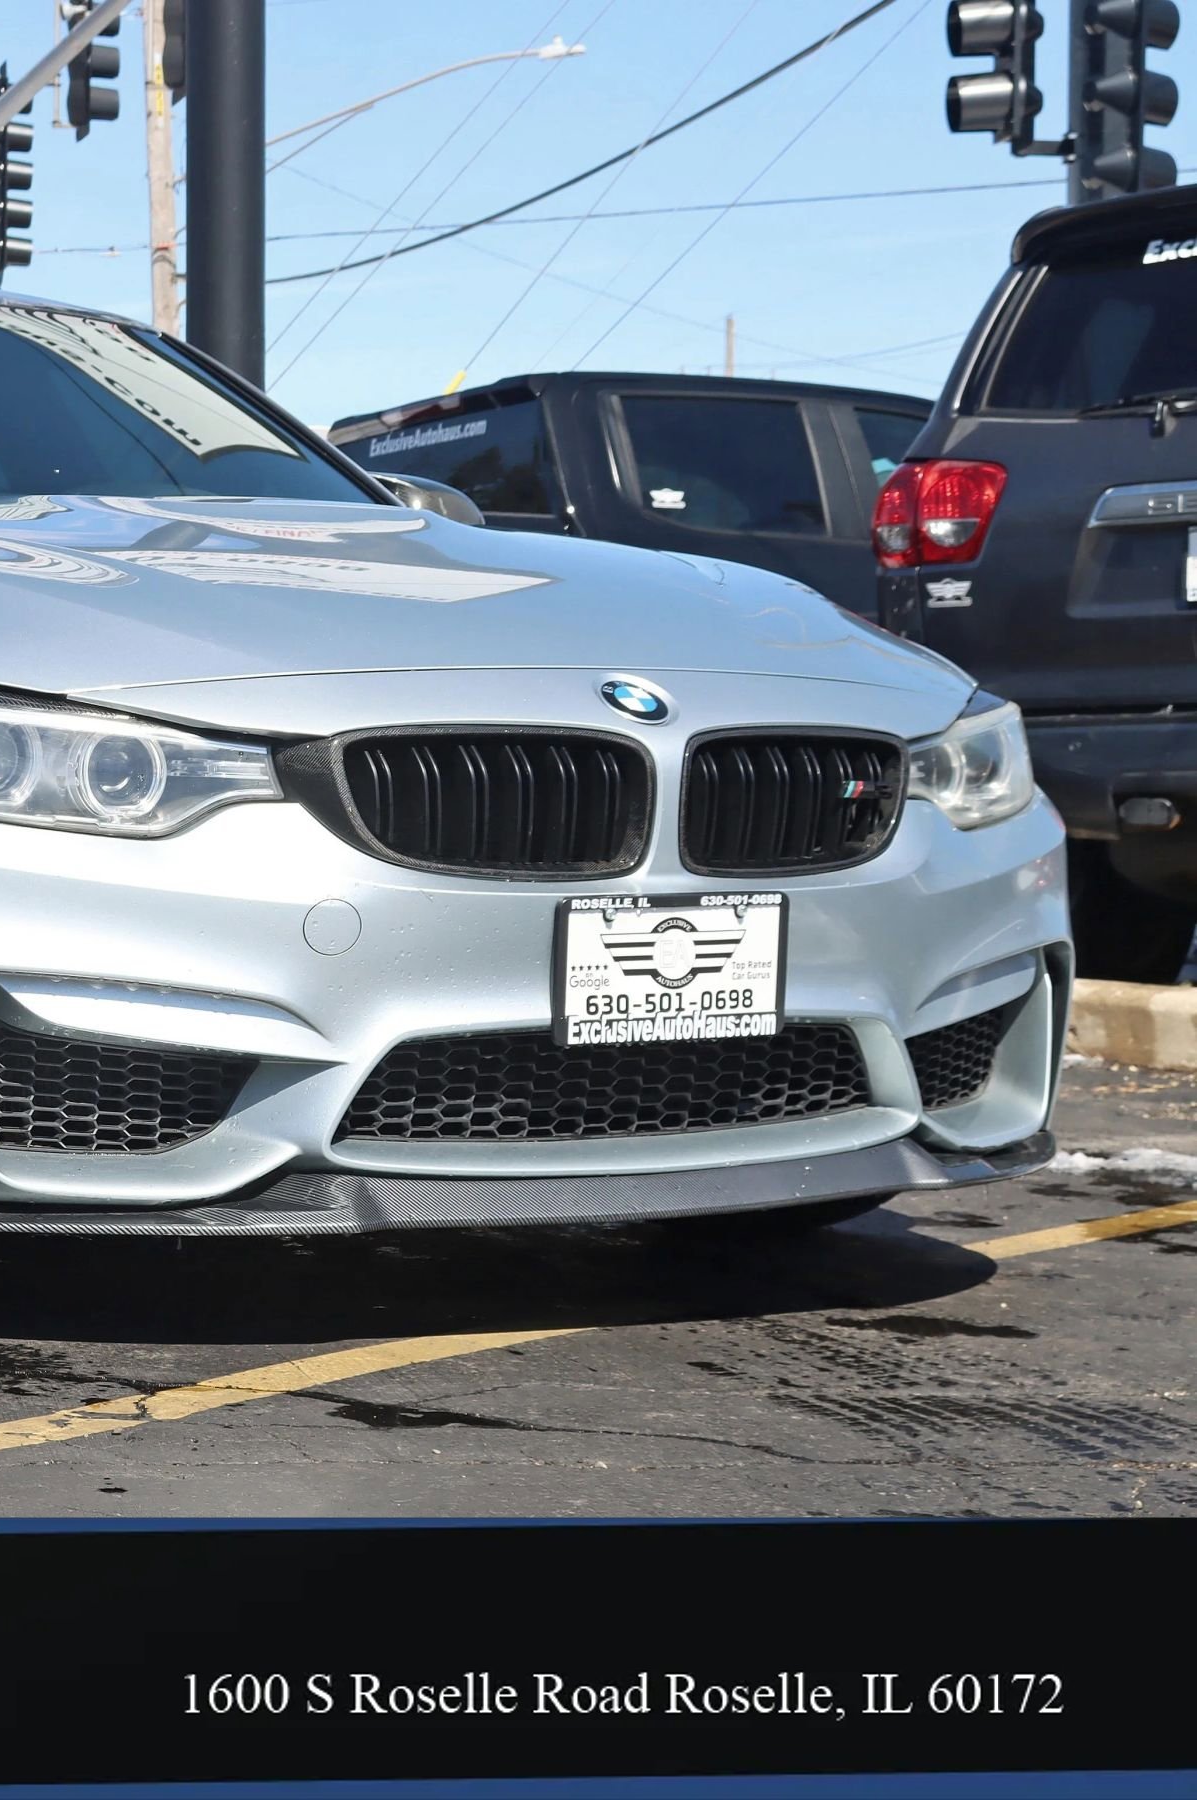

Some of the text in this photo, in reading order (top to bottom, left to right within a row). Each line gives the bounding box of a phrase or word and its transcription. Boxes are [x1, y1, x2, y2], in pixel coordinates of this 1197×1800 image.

[571, 897, 651, 910] ROSELLE, IL
[700, 893, 782, 906] 630-501-0698
[657, 919, 693, 933] EXCLUSIVE
[569, 975, 611, 991] Google
[655, 974, 694, 988] AUTOHAUS
[586, 989, 754, 1016] 630-501-0698
